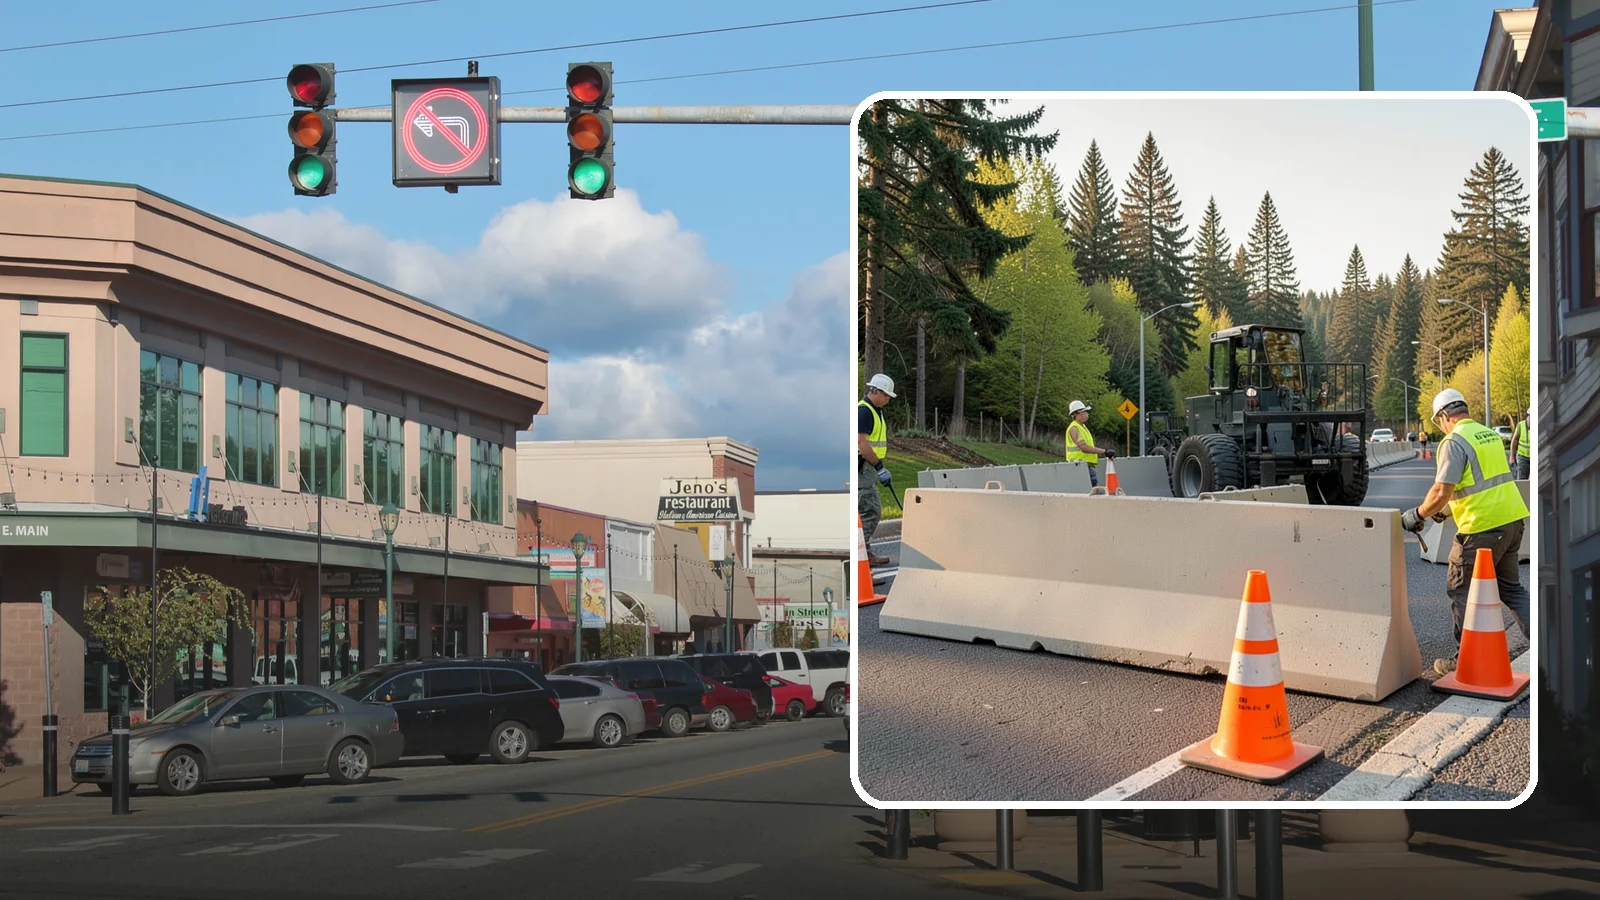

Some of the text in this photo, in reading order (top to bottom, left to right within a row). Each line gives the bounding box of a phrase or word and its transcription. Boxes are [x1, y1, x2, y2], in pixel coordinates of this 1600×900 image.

[670, 480, 727, 494] Jeno's
[665, 496, 731, 509] restaurant
[658, 509, 681, 519] Italian
[686, 509, 714, 519] American
[714, 509, 738, 519] Cuisine
[2, 525, 49, 536] E. MAIN
[786, 607, 795, 616] in
[797, 607, 828, 617] Street
[790, 619, 823, 627] lass
